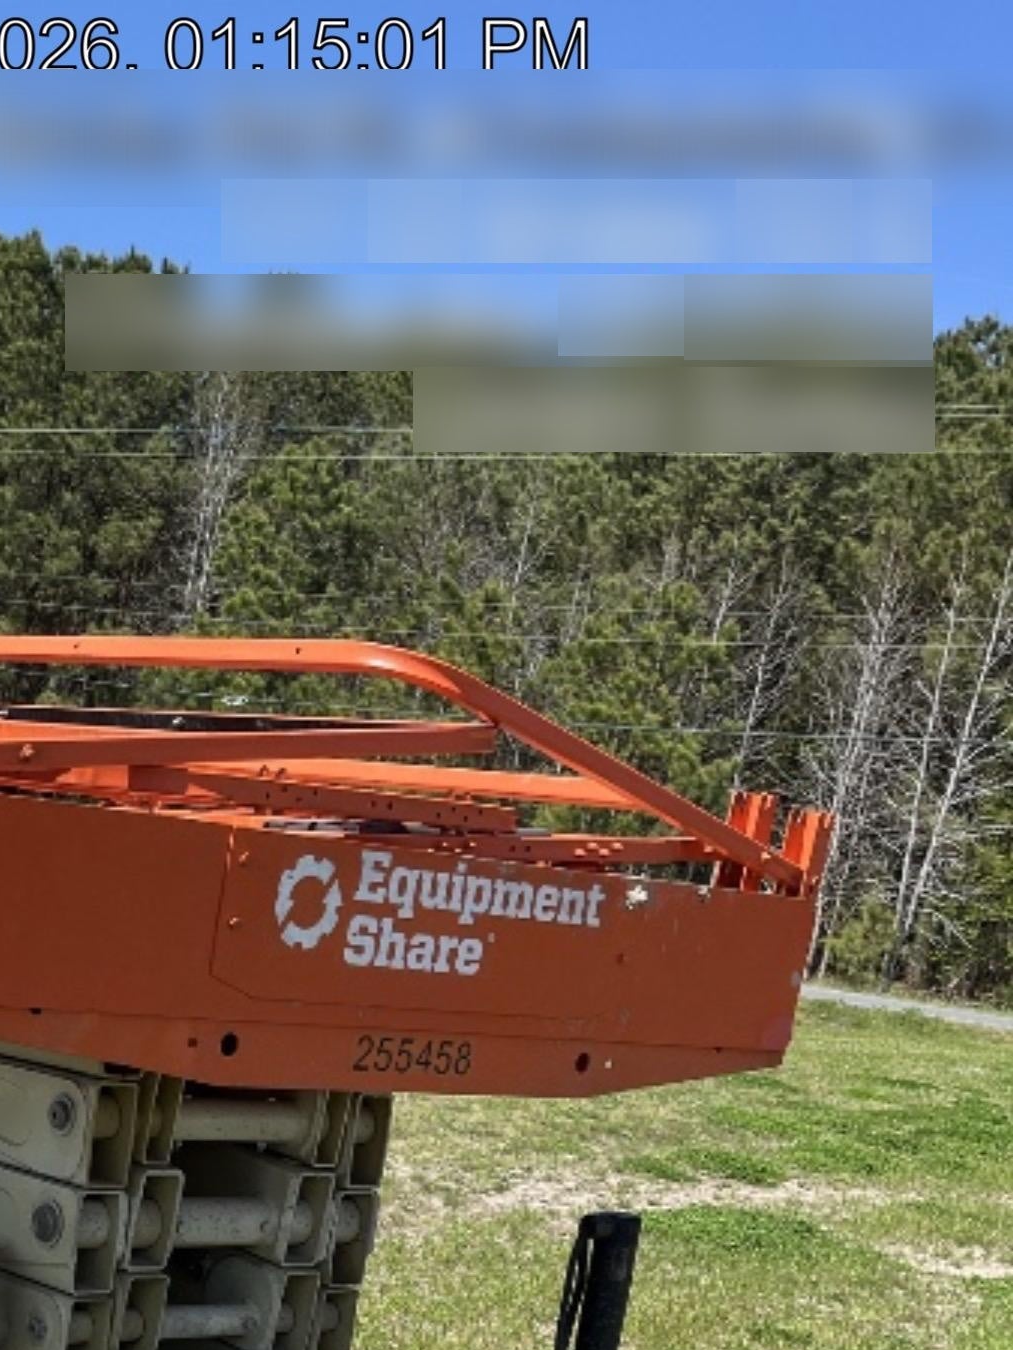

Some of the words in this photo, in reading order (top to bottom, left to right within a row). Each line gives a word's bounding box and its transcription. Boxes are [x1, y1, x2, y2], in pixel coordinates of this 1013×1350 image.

[353, 849, 606, 928] Equipment
[343, 914, 484, 976] Share
[352, 1034, 472, 1075] 255458
